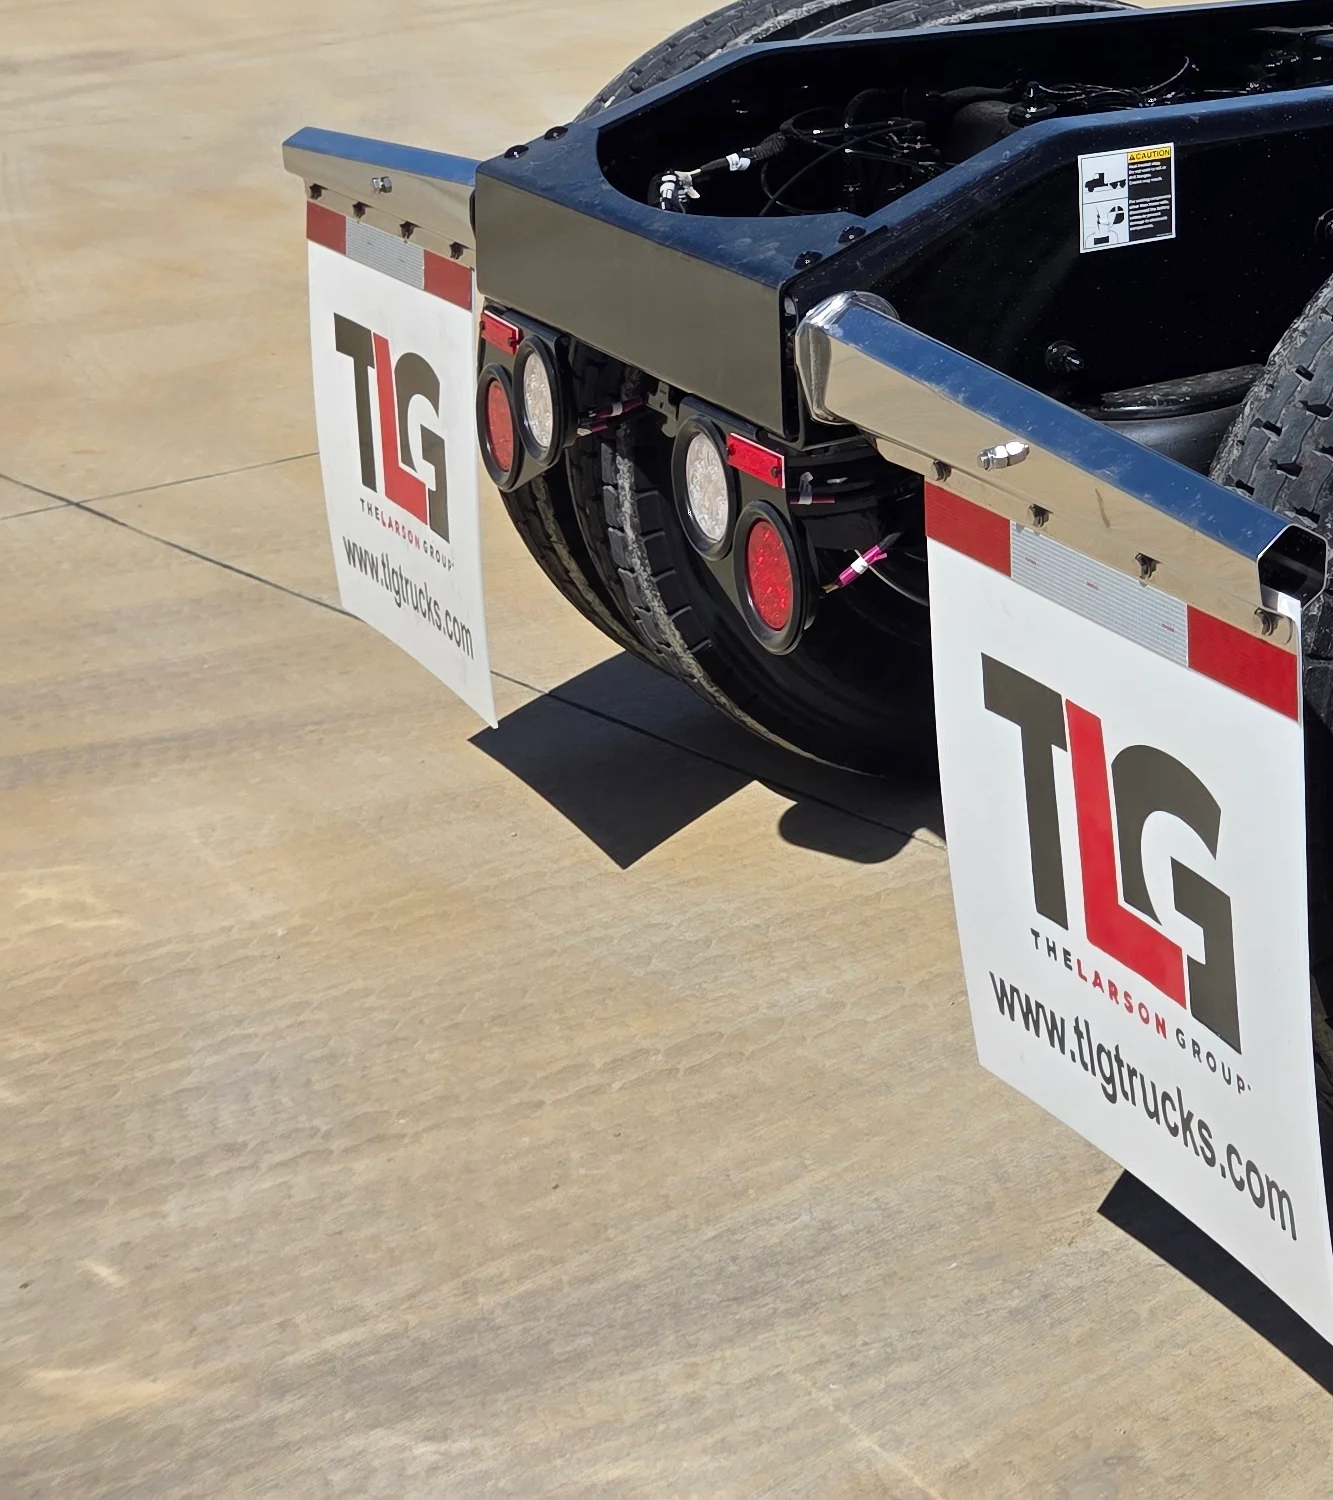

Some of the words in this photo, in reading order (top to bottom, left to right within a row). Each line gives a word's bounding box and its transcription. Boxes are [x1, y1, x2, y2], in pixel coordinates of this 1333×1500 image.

[1135, 149, 1170, 160] CAUTION
[333, 311, 450, 544] TLG
[342, 535, 475, 660] www.tlgtrucks.com
[423, 540, 453, 572] GROUP
[981, 652, 1242, 1055] TLG
[988, 970, 1298, 1241] www.tlgtrucks.com
[1175, 1027, 1247, 1094] GROUP
